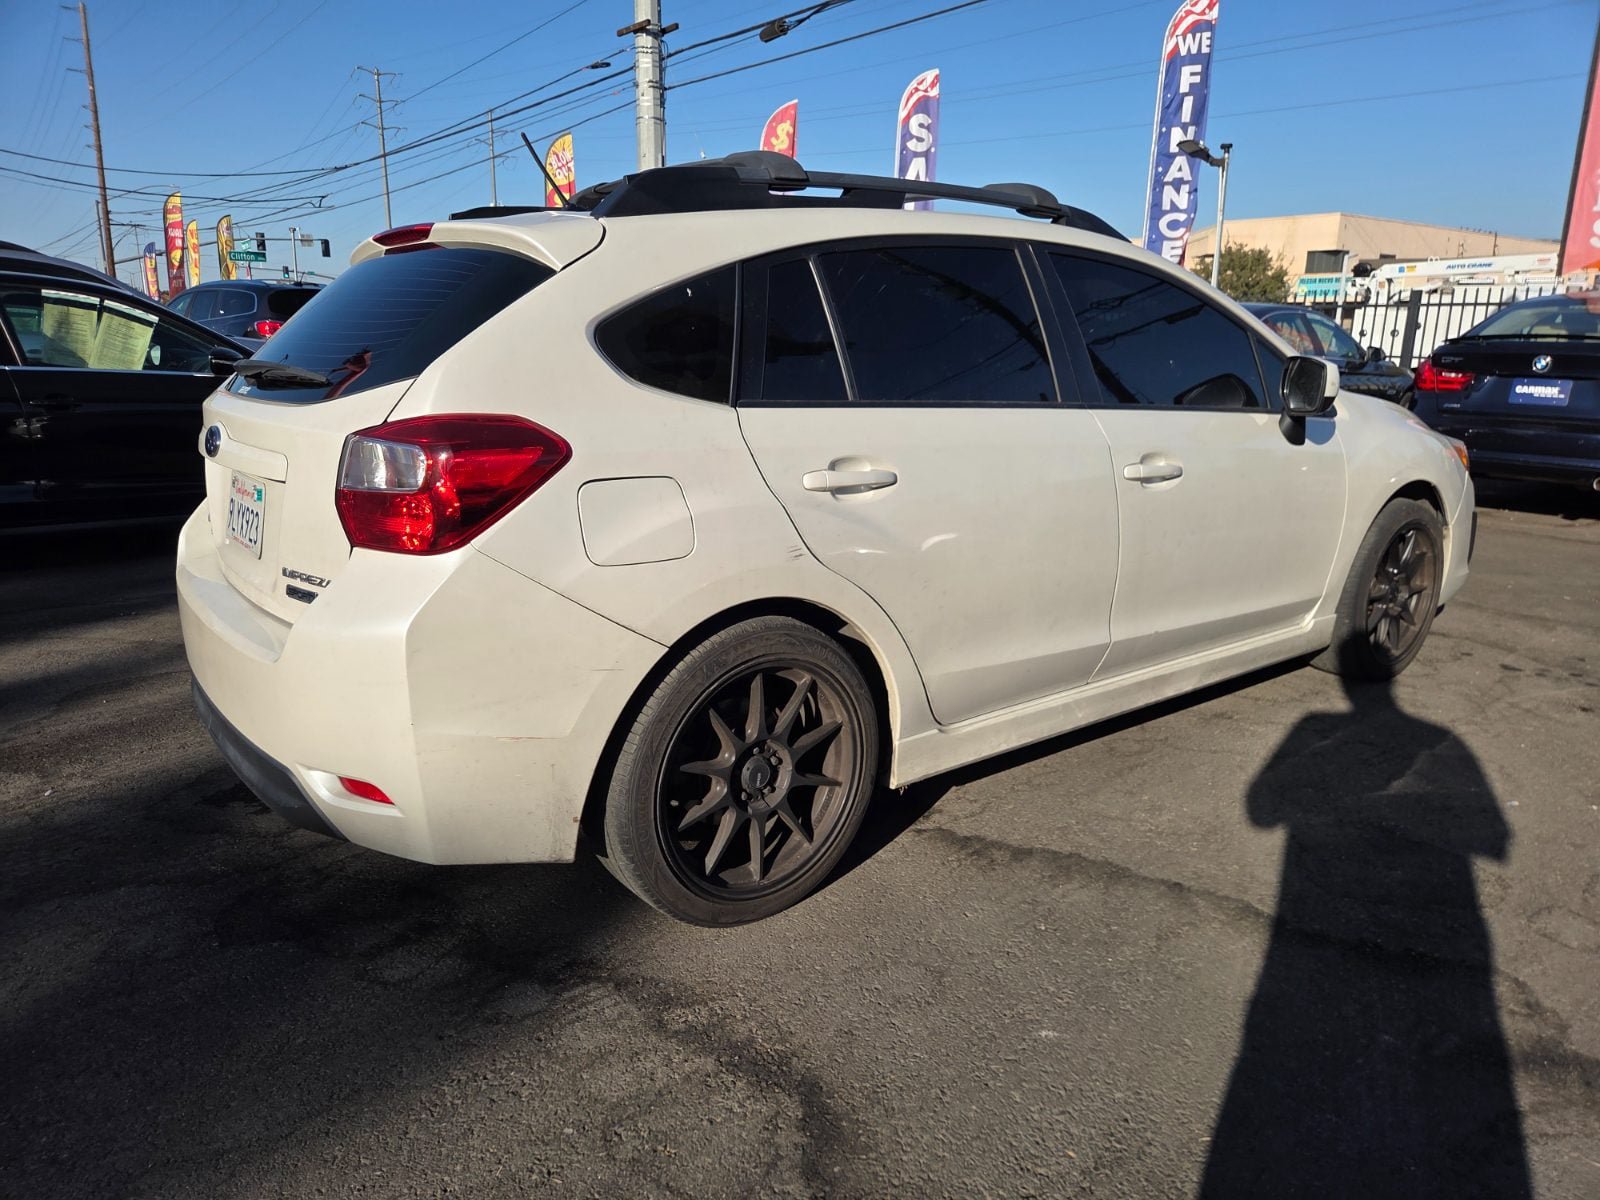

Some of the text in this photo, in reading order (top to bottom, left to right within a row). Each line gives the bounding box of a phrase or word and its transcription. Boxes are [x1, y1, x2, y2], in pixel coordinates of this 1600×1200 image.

[1159, 31, 1211, 264] WE FINANCE
[230, 252, 256, 261] Clifton
[1446, 262, 1466, 270] AUTO
